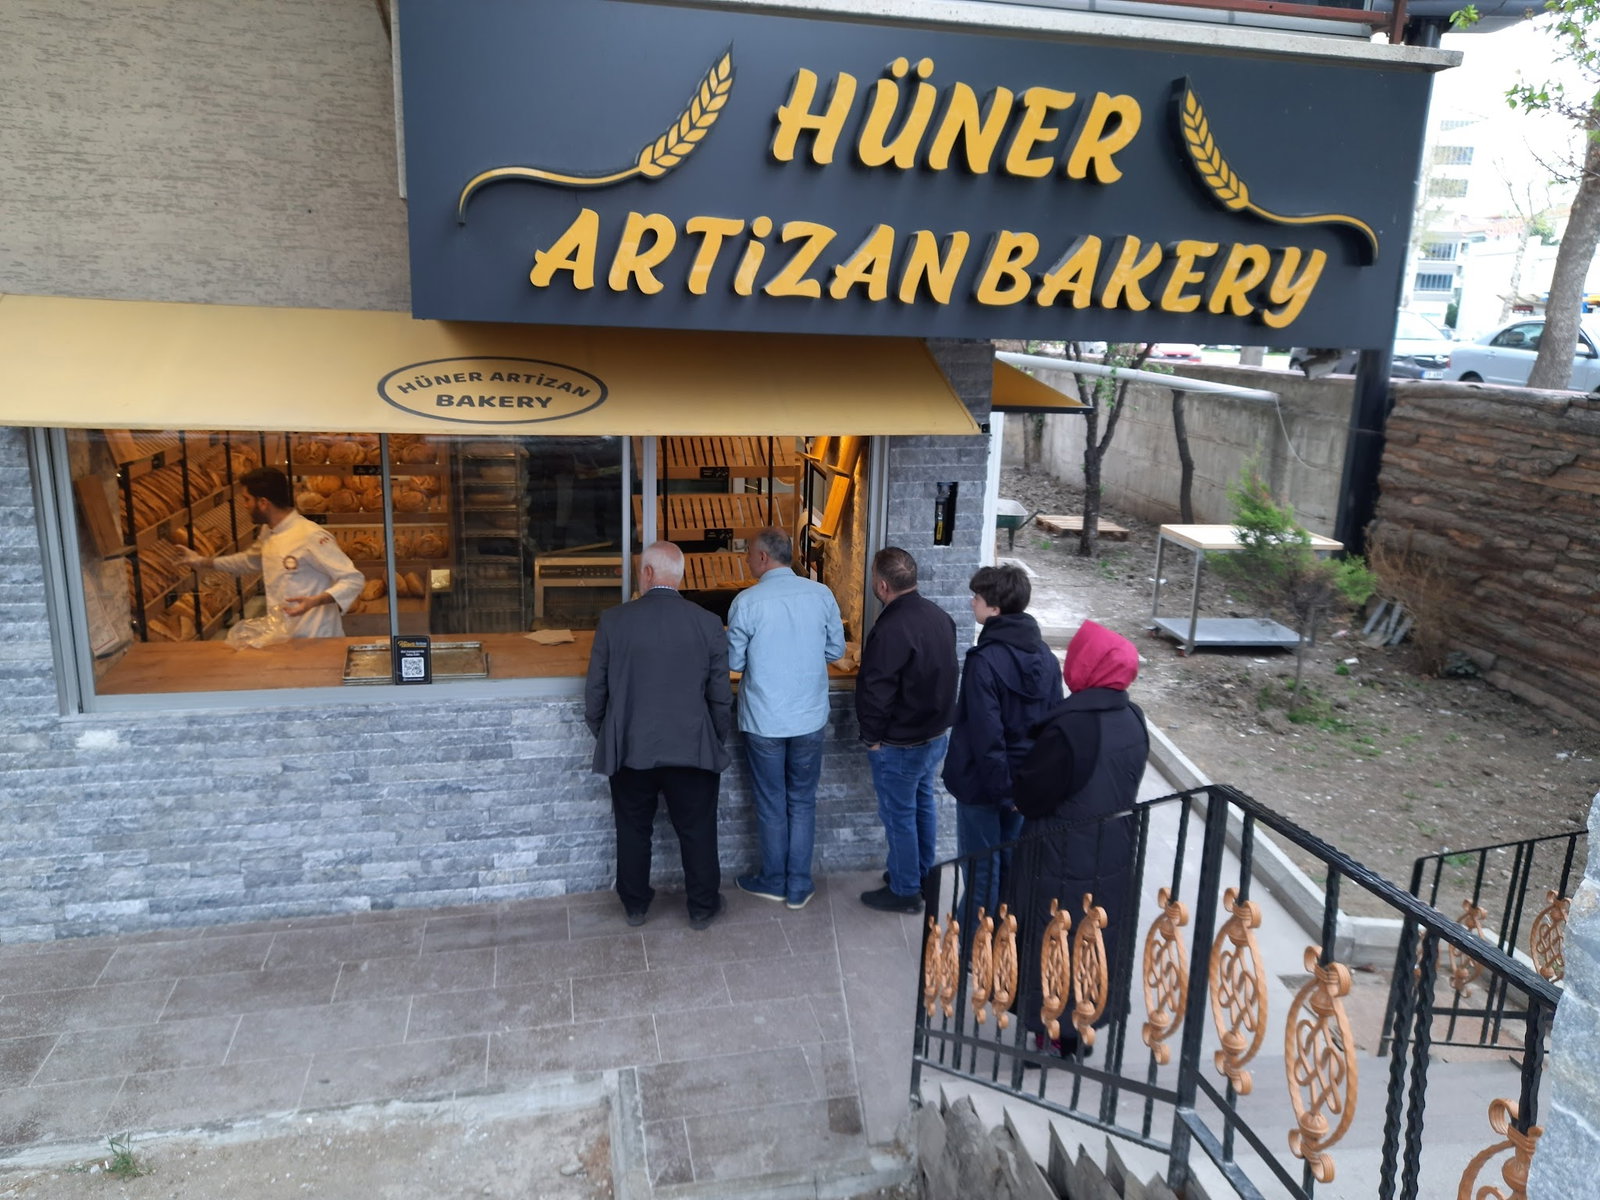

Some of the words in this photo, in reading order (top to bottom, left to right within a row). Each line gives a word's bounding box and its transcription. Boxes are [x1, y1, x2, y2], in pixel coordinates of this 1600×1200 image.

[772, 57, 1142, 184] HÜNER
[977, 231, 1327, 329] BAKERY
[396, 372, 484, 395] HÜNER
[436, 394, 553, 409] BAKERY
